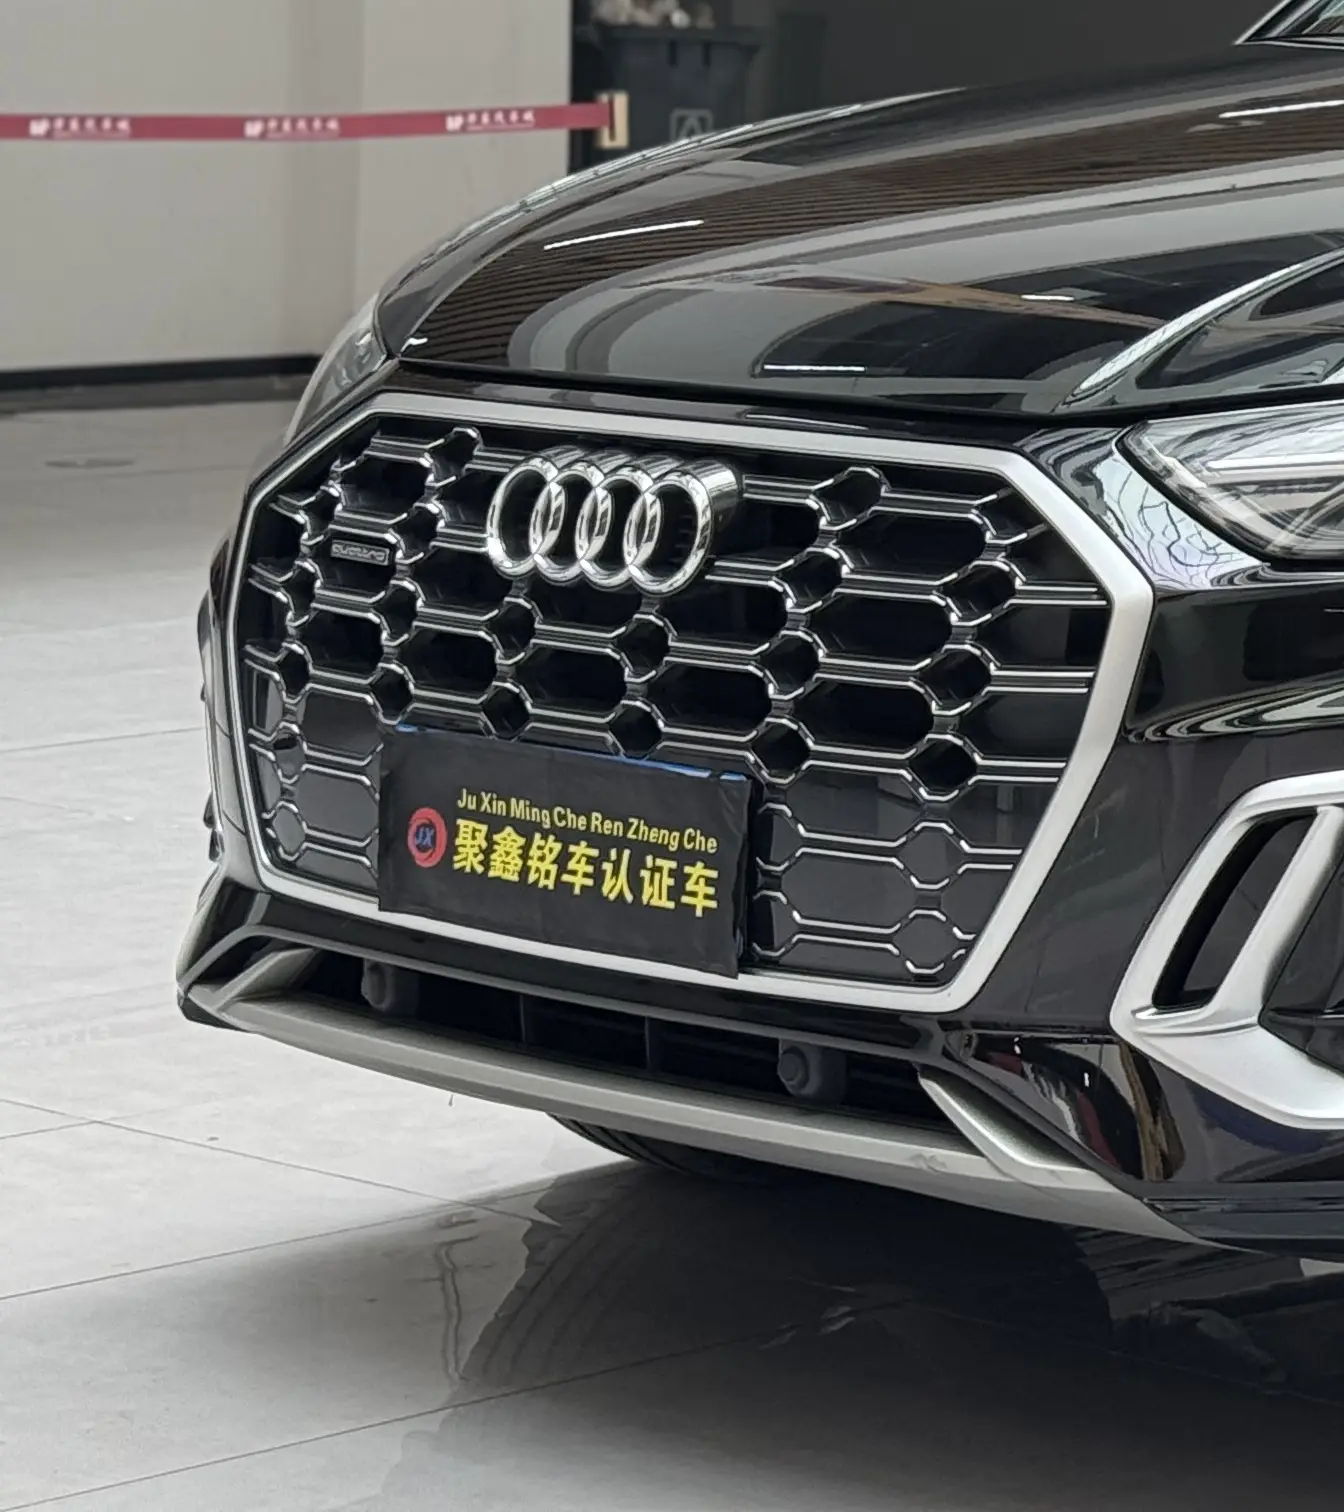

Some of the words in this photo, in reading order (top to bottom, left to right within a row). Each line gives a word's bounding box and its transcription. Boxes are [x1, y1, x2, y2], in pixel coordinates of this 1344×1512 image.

[457, 788, 477, 810] Ju
[481, 791, 507, 817] Xin
[510, 798, 551, 829] Ming
[553, 806, 588, 832] Che
[591, 811, 624, 838] Ren
[627, 818, 681, 851] Zheng
[684, 827, 718, 855] Che
[452, 817, 719, 918] 聚鑫铭车认证车
